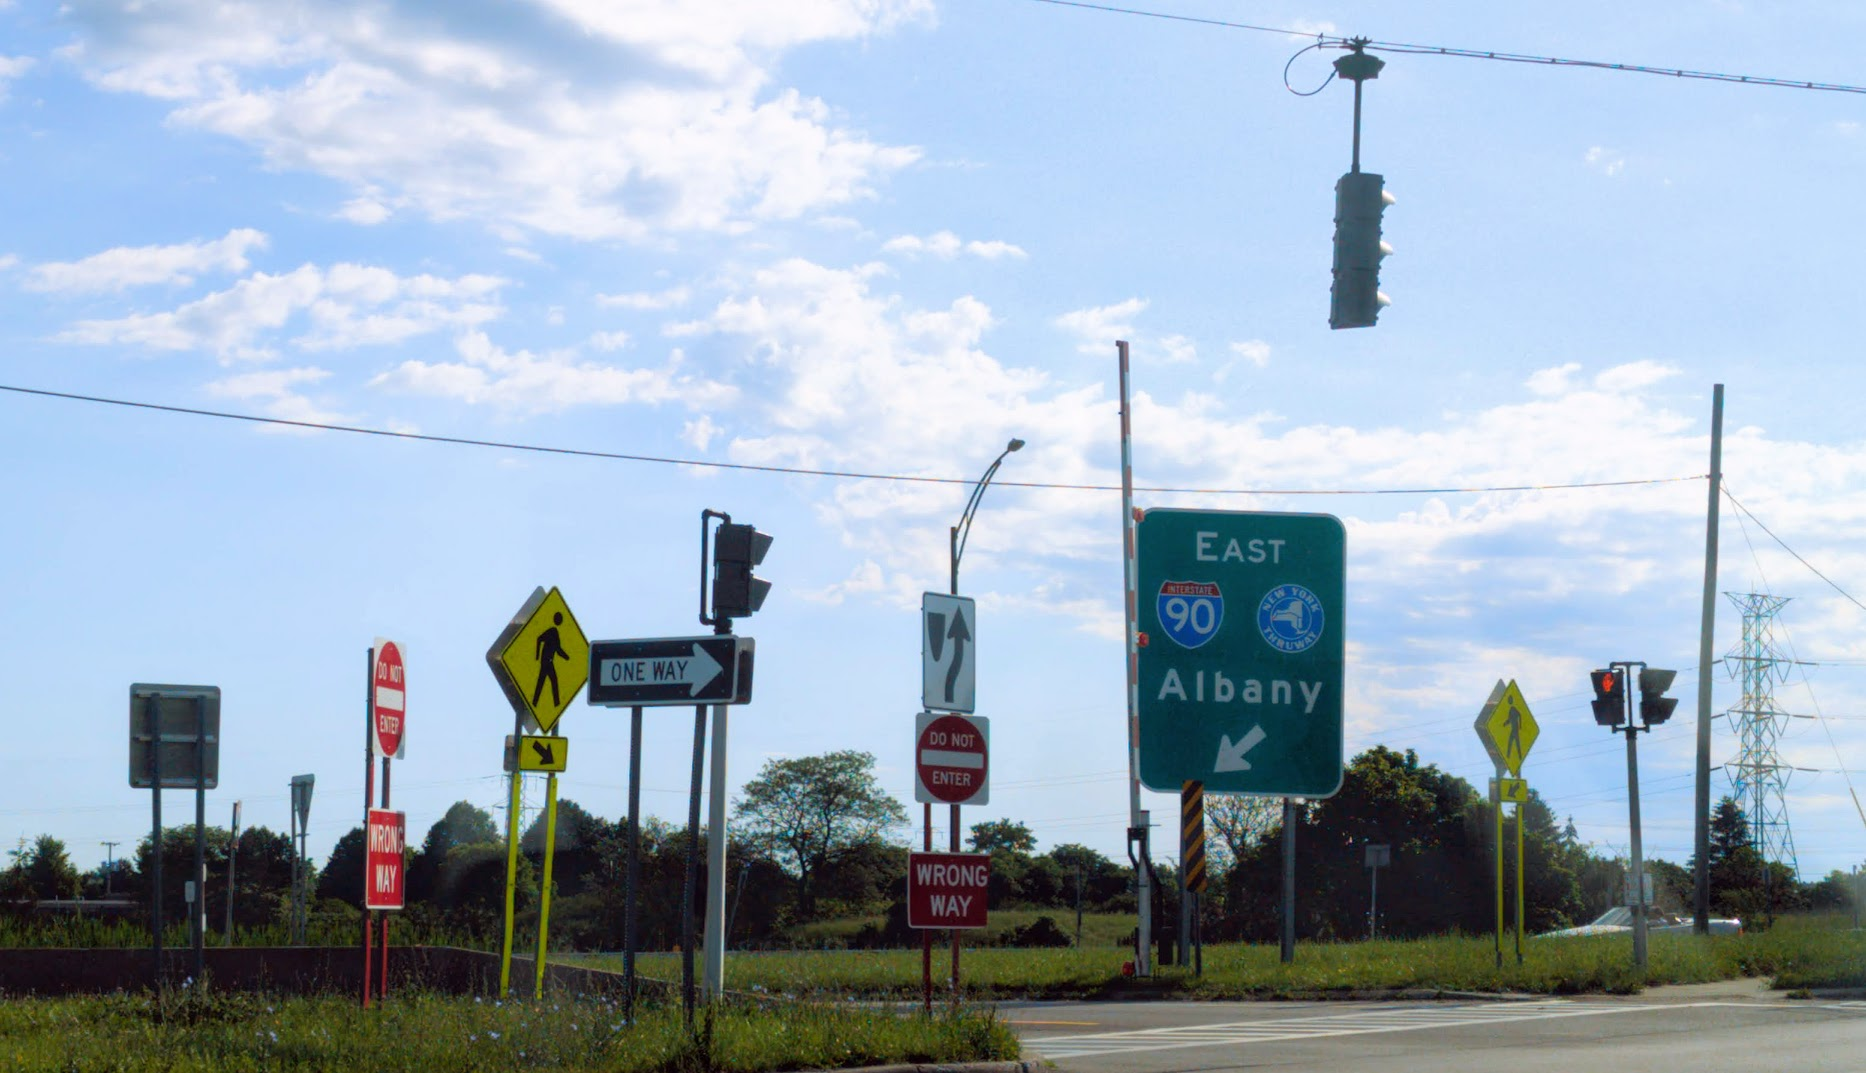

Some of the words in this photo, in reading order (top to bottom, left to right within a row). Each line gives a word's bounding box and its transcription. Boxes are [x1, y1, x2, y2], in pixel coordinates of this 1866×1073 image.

[1196, 531, 1286, 564] EAST
[1167, 584, 1213, 595] INTERSTATE
[1262, 587, 1286, 611] NEW
[1292, 587, 1320, 612] YORK
[1166, 597, 1215, 635] 90
[1264, 626, 1317, 650] THRUWAY
[378, 661, 387, 680] DO
[390, 664, 402, 683] NOT
[611, 662, 645, 682] ONE
[653, 660, 688, 681] WAY
[1157, 667, 1323, 714] Albany
[380, 714, 399, 735] ENTER
[930, 731, 947, 746] DO
[951, 733, 975, 748] NOT
[932, 770, 971, 787] ENTER
[370, 823, 404, 854] WRONG
[376, 864, 397, 893] WAY
[917, 863, 989, 887] WRONG
[930, 894, 973, 918] WAY
